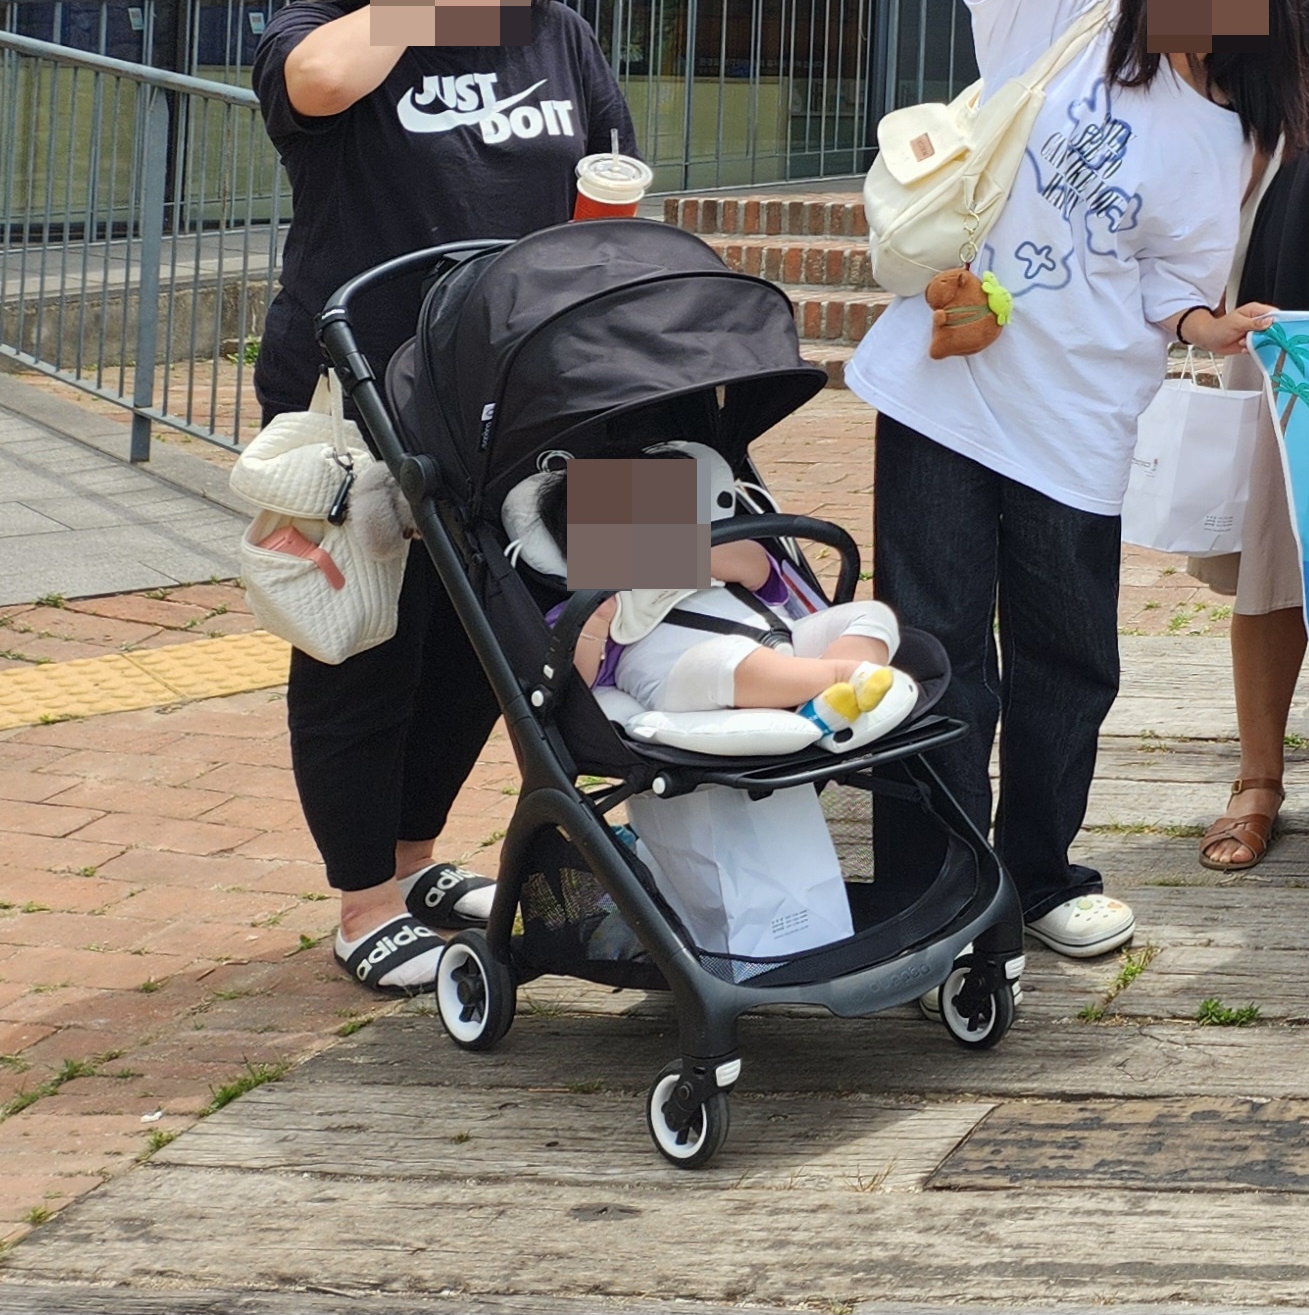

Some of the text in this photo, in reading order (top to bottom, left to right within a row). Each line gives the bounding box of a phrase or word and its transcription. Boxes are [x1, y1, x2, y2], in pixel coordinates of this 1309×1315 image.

[414, 73, 498, 112] JUST
[482, 100, 575, 144] DO IT
[356, 924, 438, 981] adida
